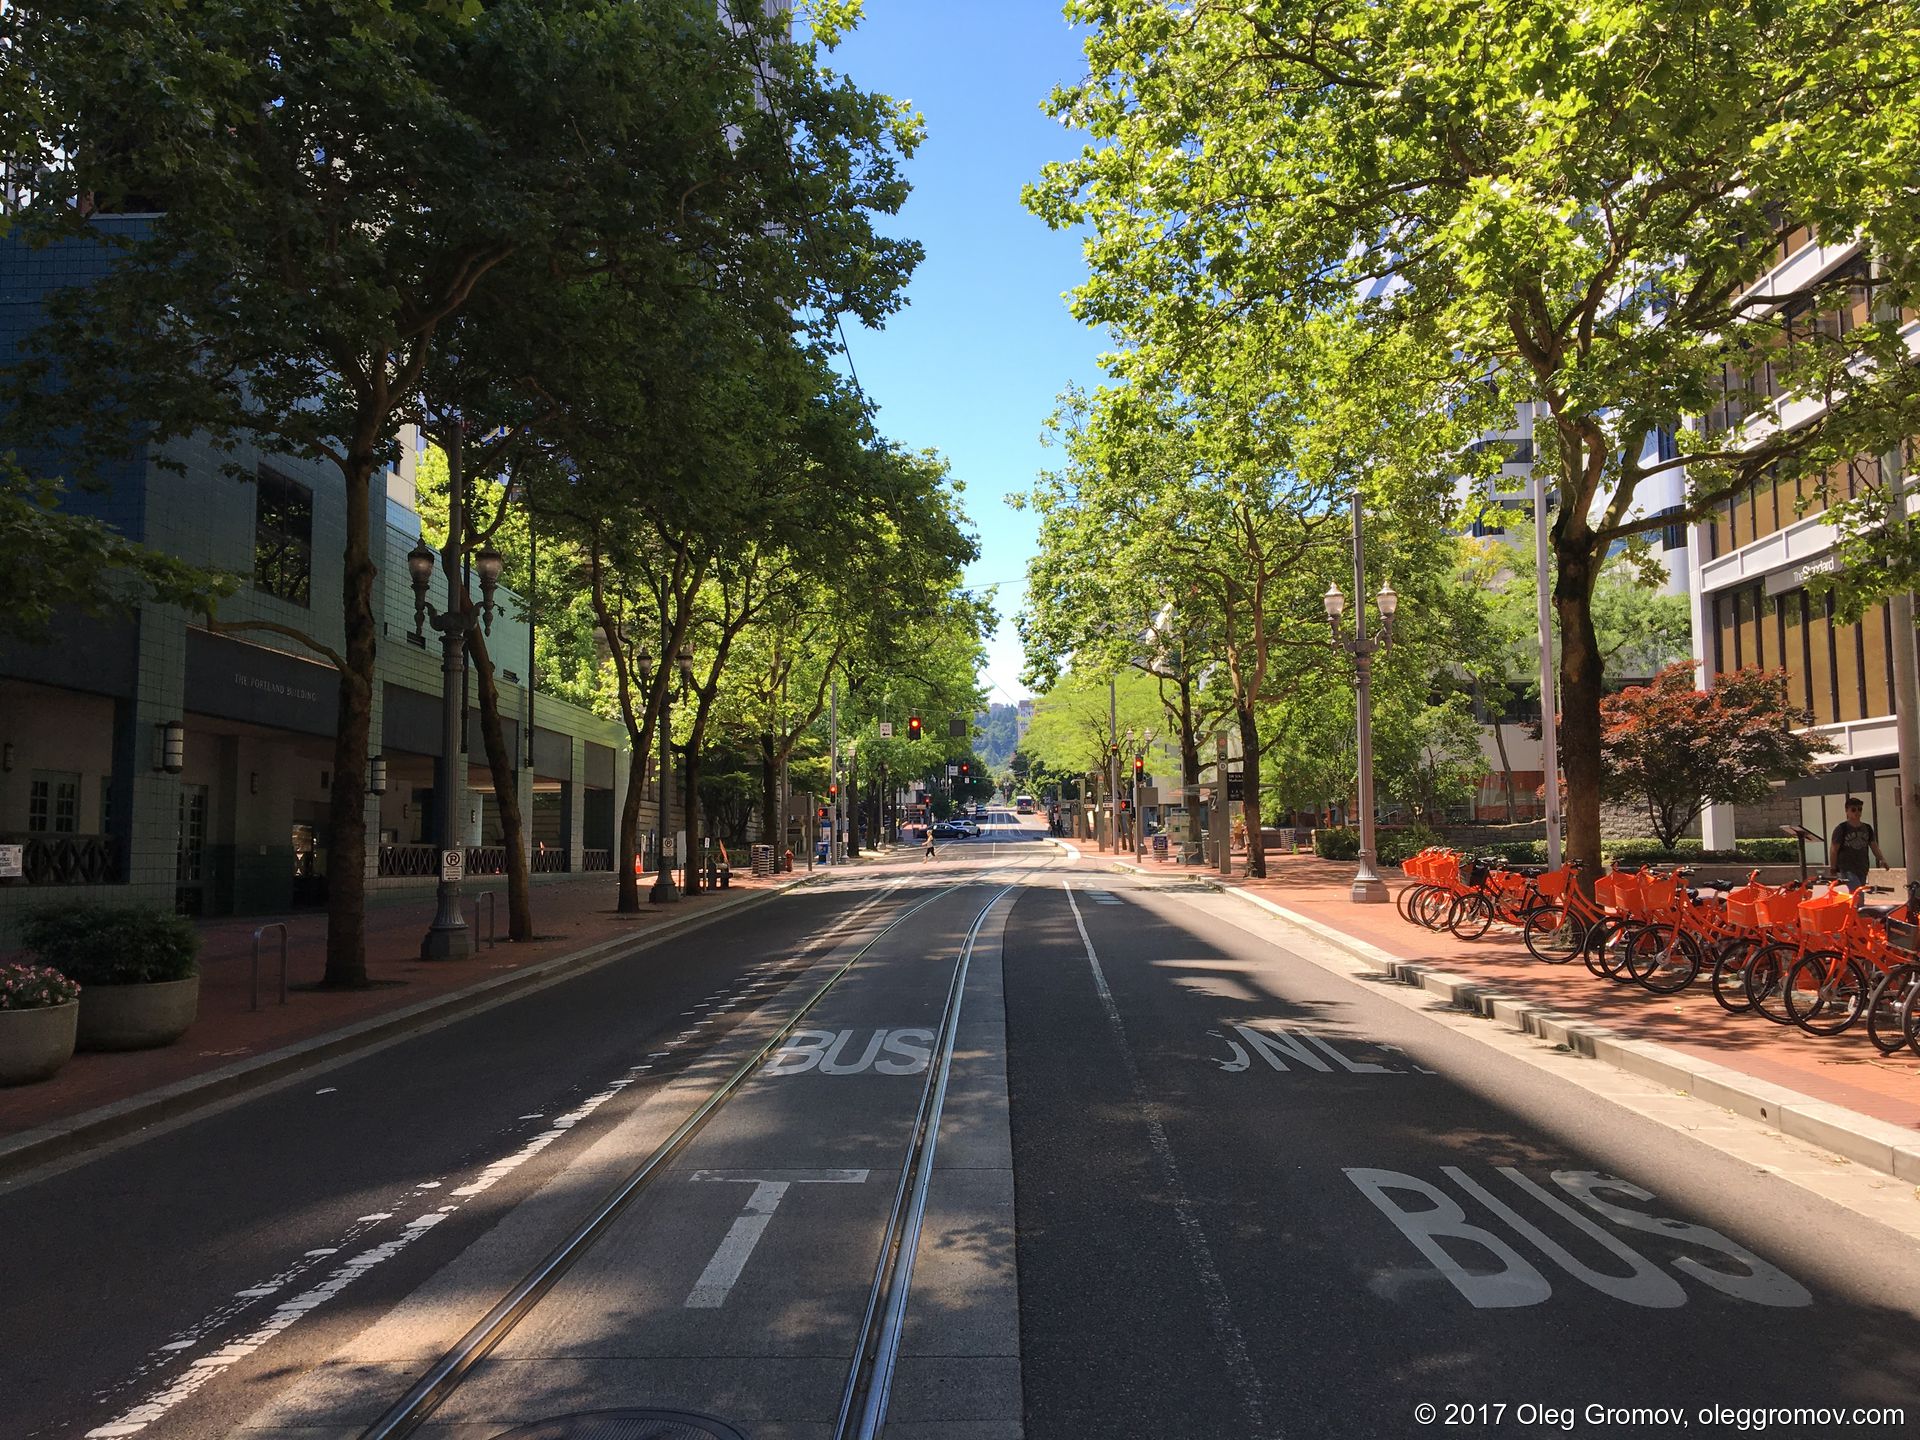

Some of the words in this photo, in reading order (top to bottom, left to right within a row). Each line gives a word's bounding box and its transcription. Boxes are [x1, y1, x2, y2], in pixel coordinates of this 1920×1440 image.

[235, 673, 247, 686] THE
[250, 677, 285, 695] PORTLAND
[286, 687, 317, 702] BUILDING
[762, 1028, 937, 1076] BUS
[1206, 1026, 1438, 1074] ONL
[1341, 1166, 1813, 1309] BUS
